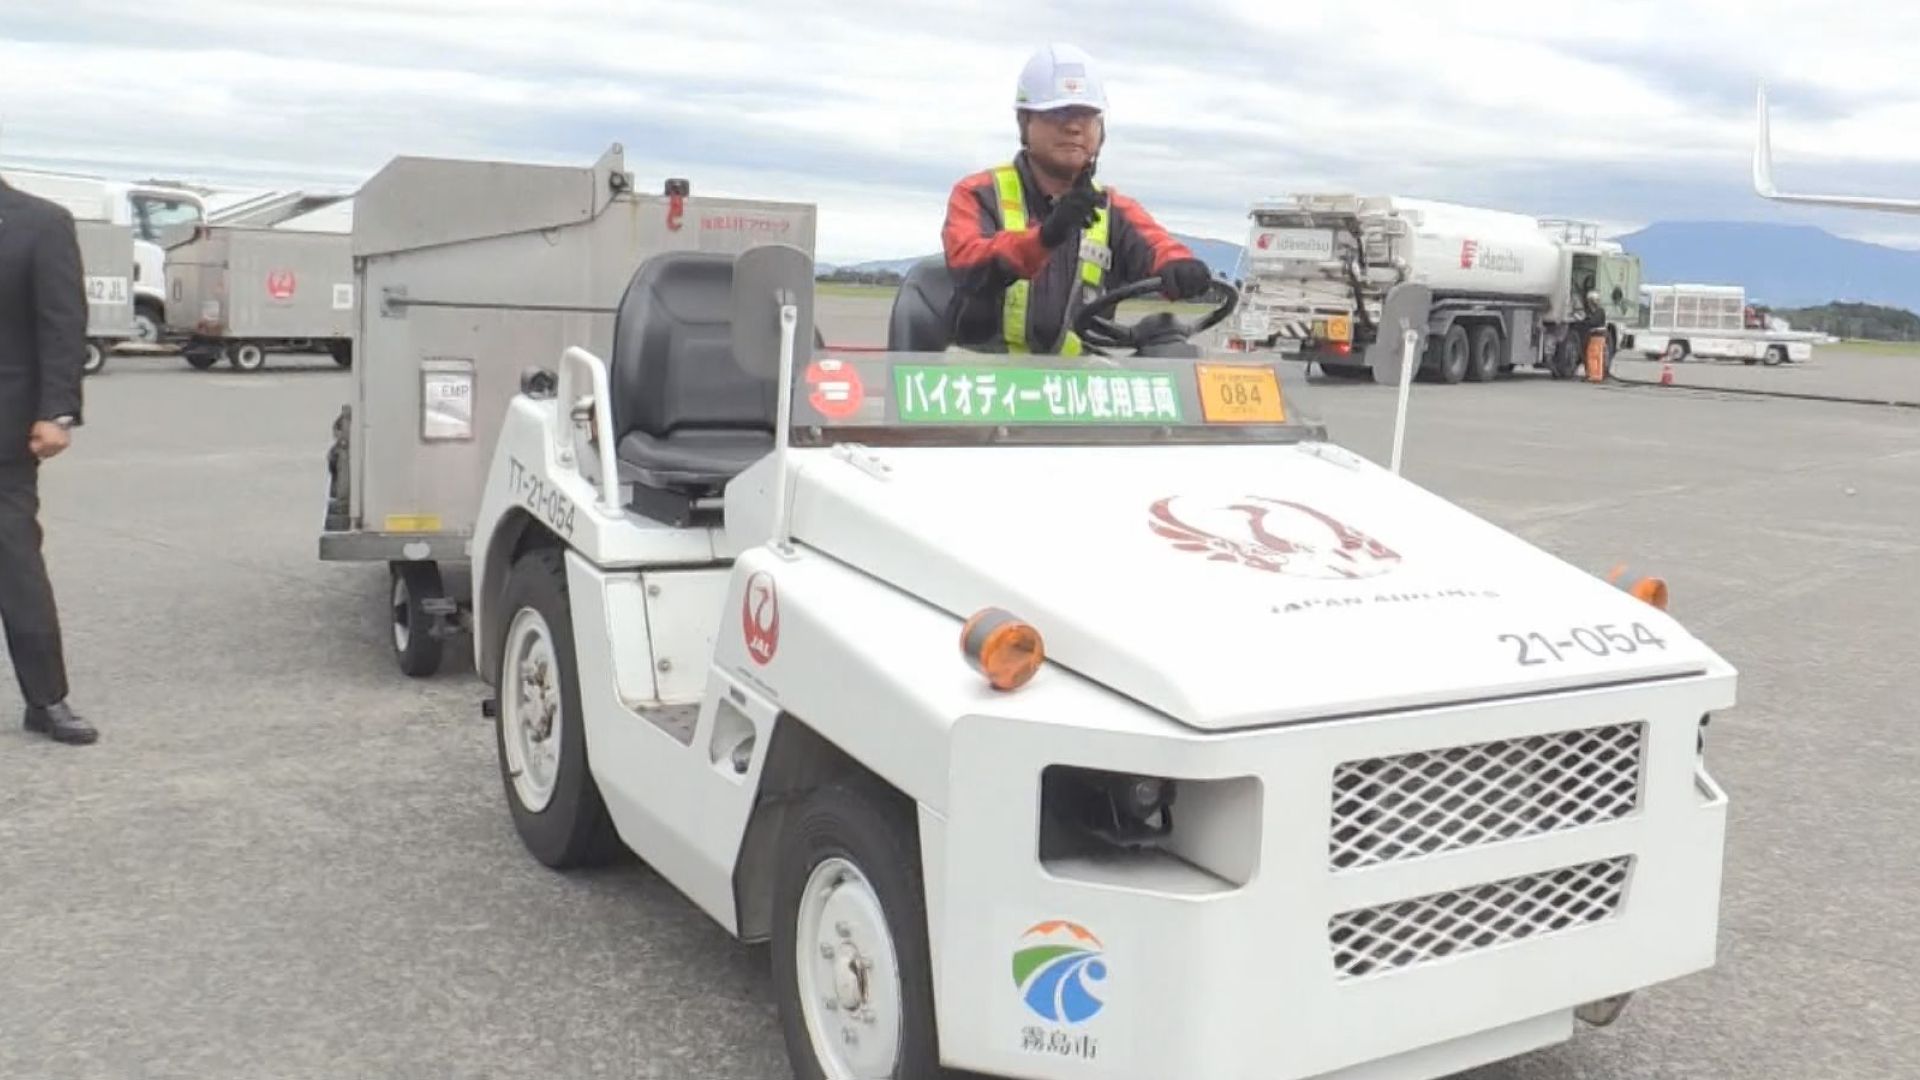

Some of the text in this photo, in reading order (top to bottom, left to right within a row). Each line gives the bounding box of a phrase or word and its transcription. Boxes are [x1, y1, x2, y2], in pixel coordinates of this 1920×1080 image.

[1220, 383, 1262, 405] 084
[508, 457, 575, 539] TT-21-054
[1498, 622, 1667, 666] 21-054
